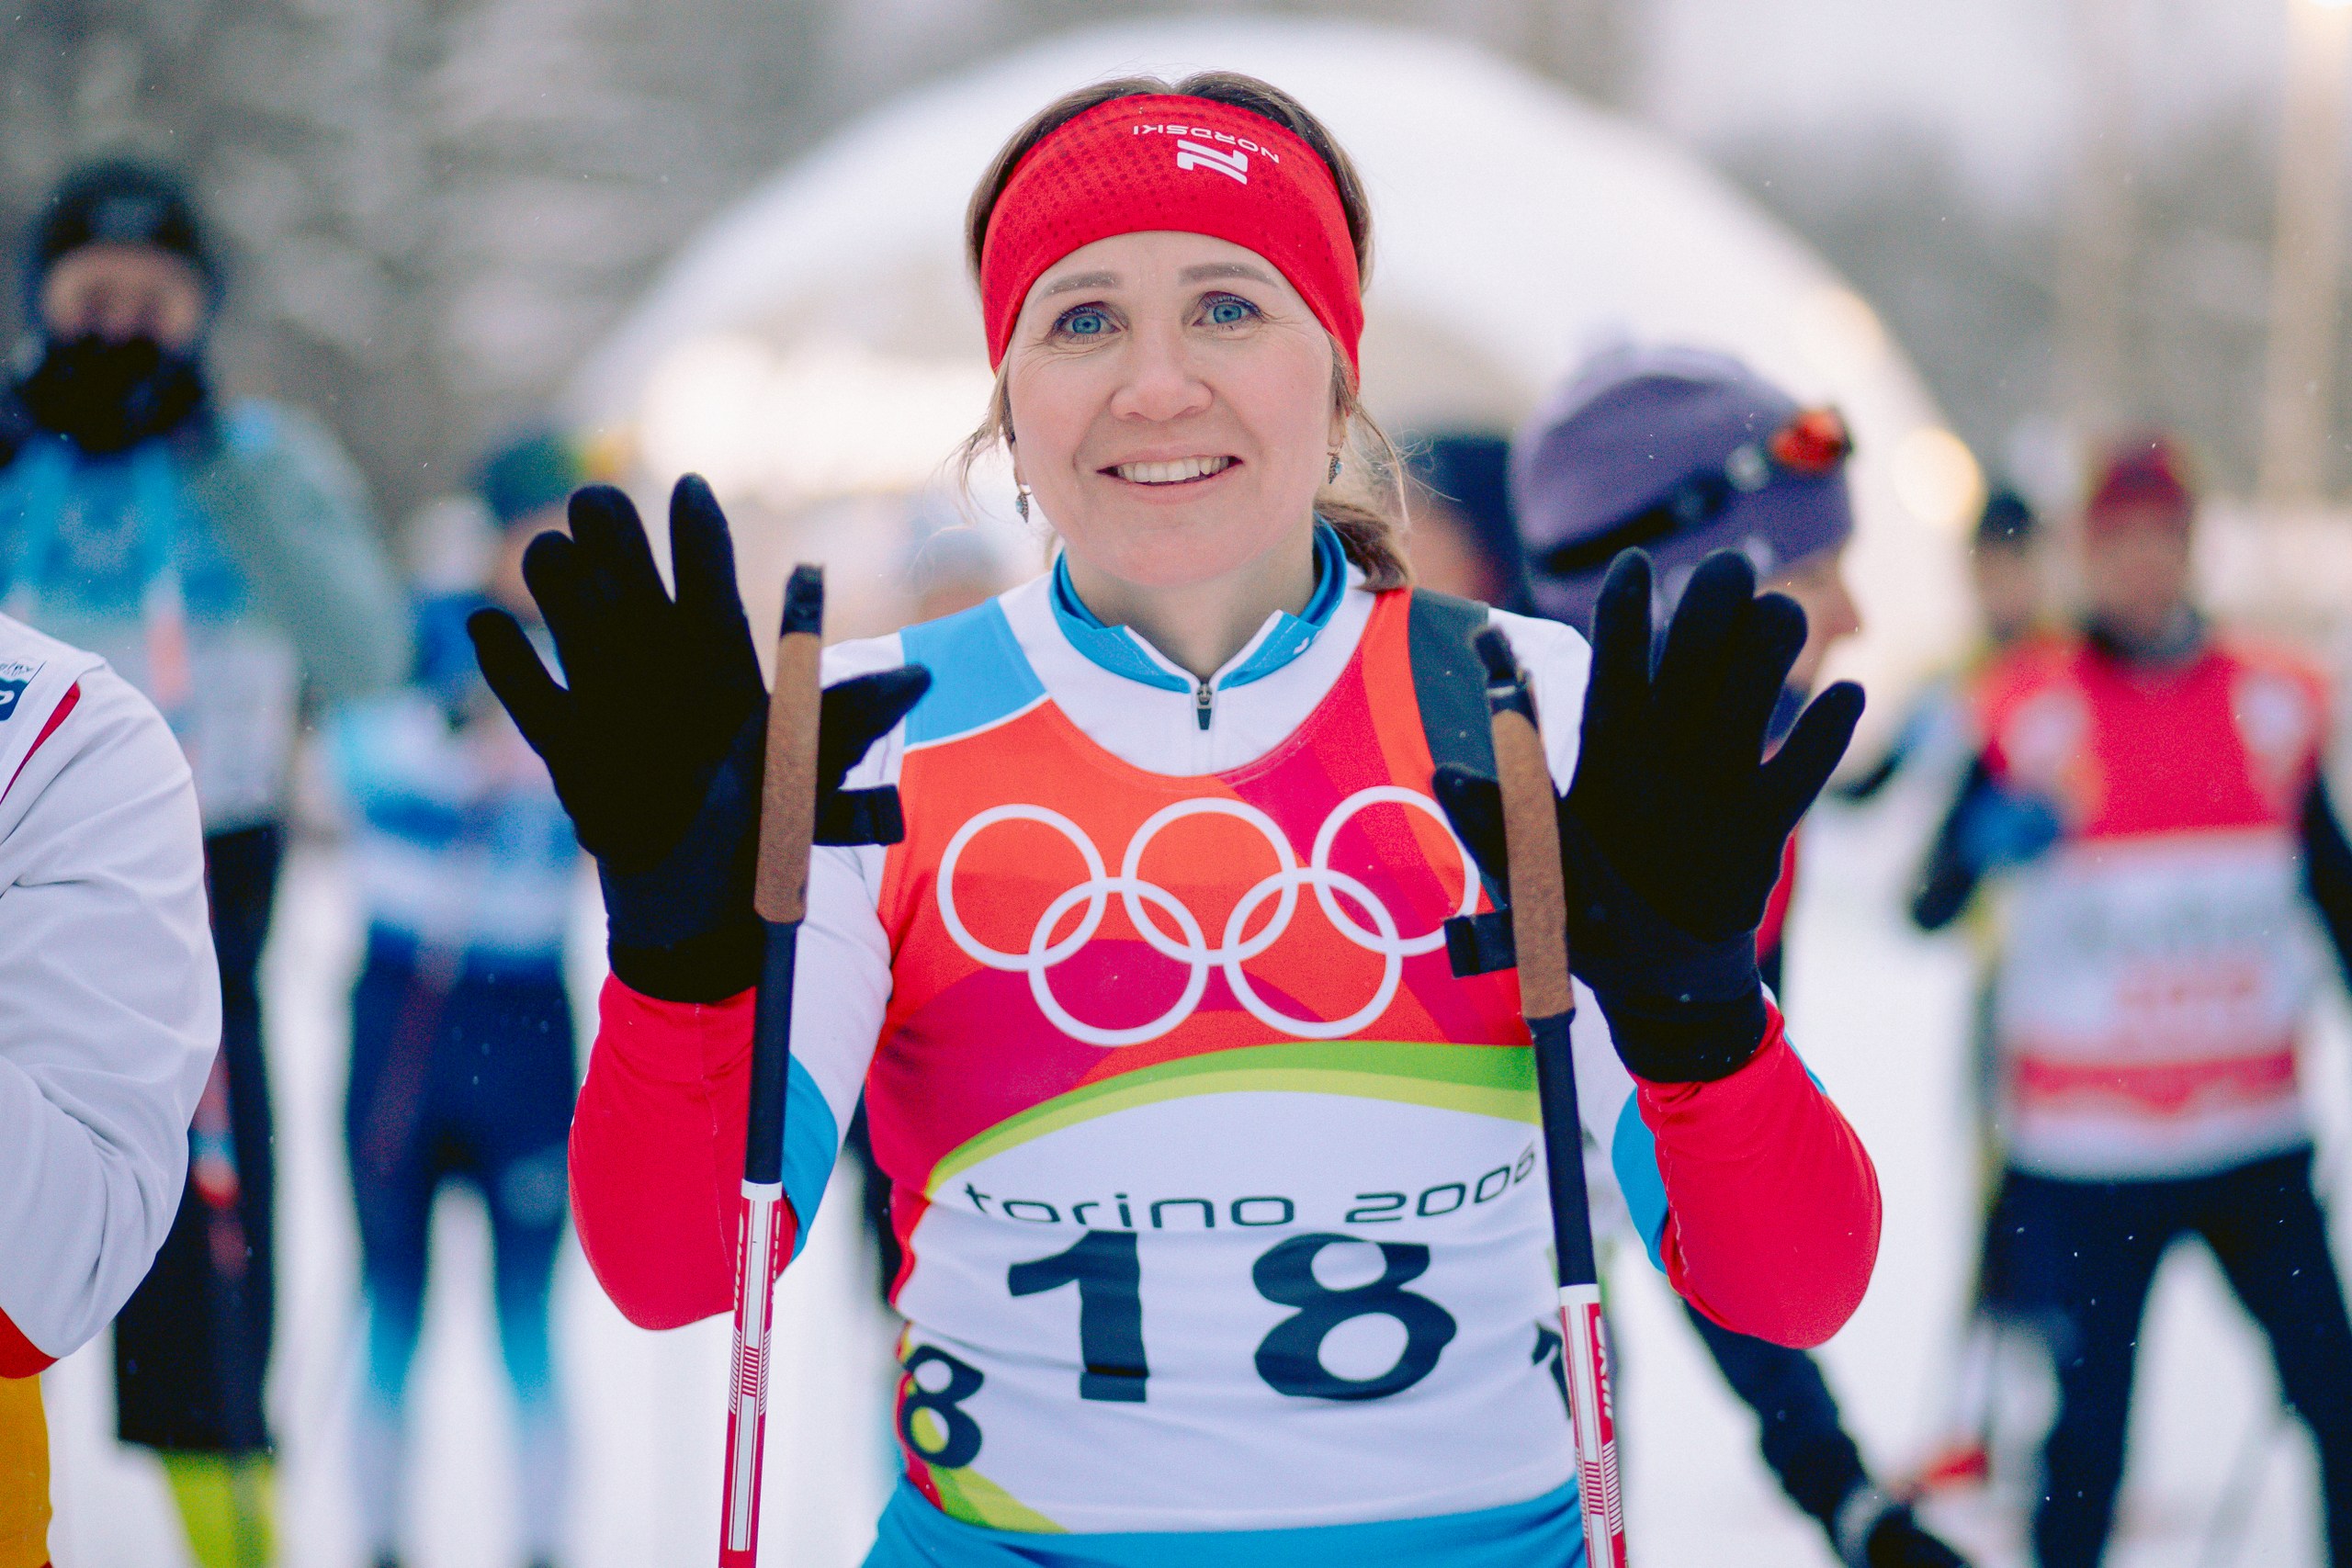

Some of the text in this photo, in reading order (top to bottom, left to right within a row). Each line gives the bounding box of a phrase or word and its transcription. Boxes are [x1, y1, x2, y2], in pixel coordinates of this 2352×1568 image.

[1133, 124, 1280, 164] NORDSKI
[965, 1143, 1535, 1228] torino 2006
[1007, 1229, 1457, 1401] 18
